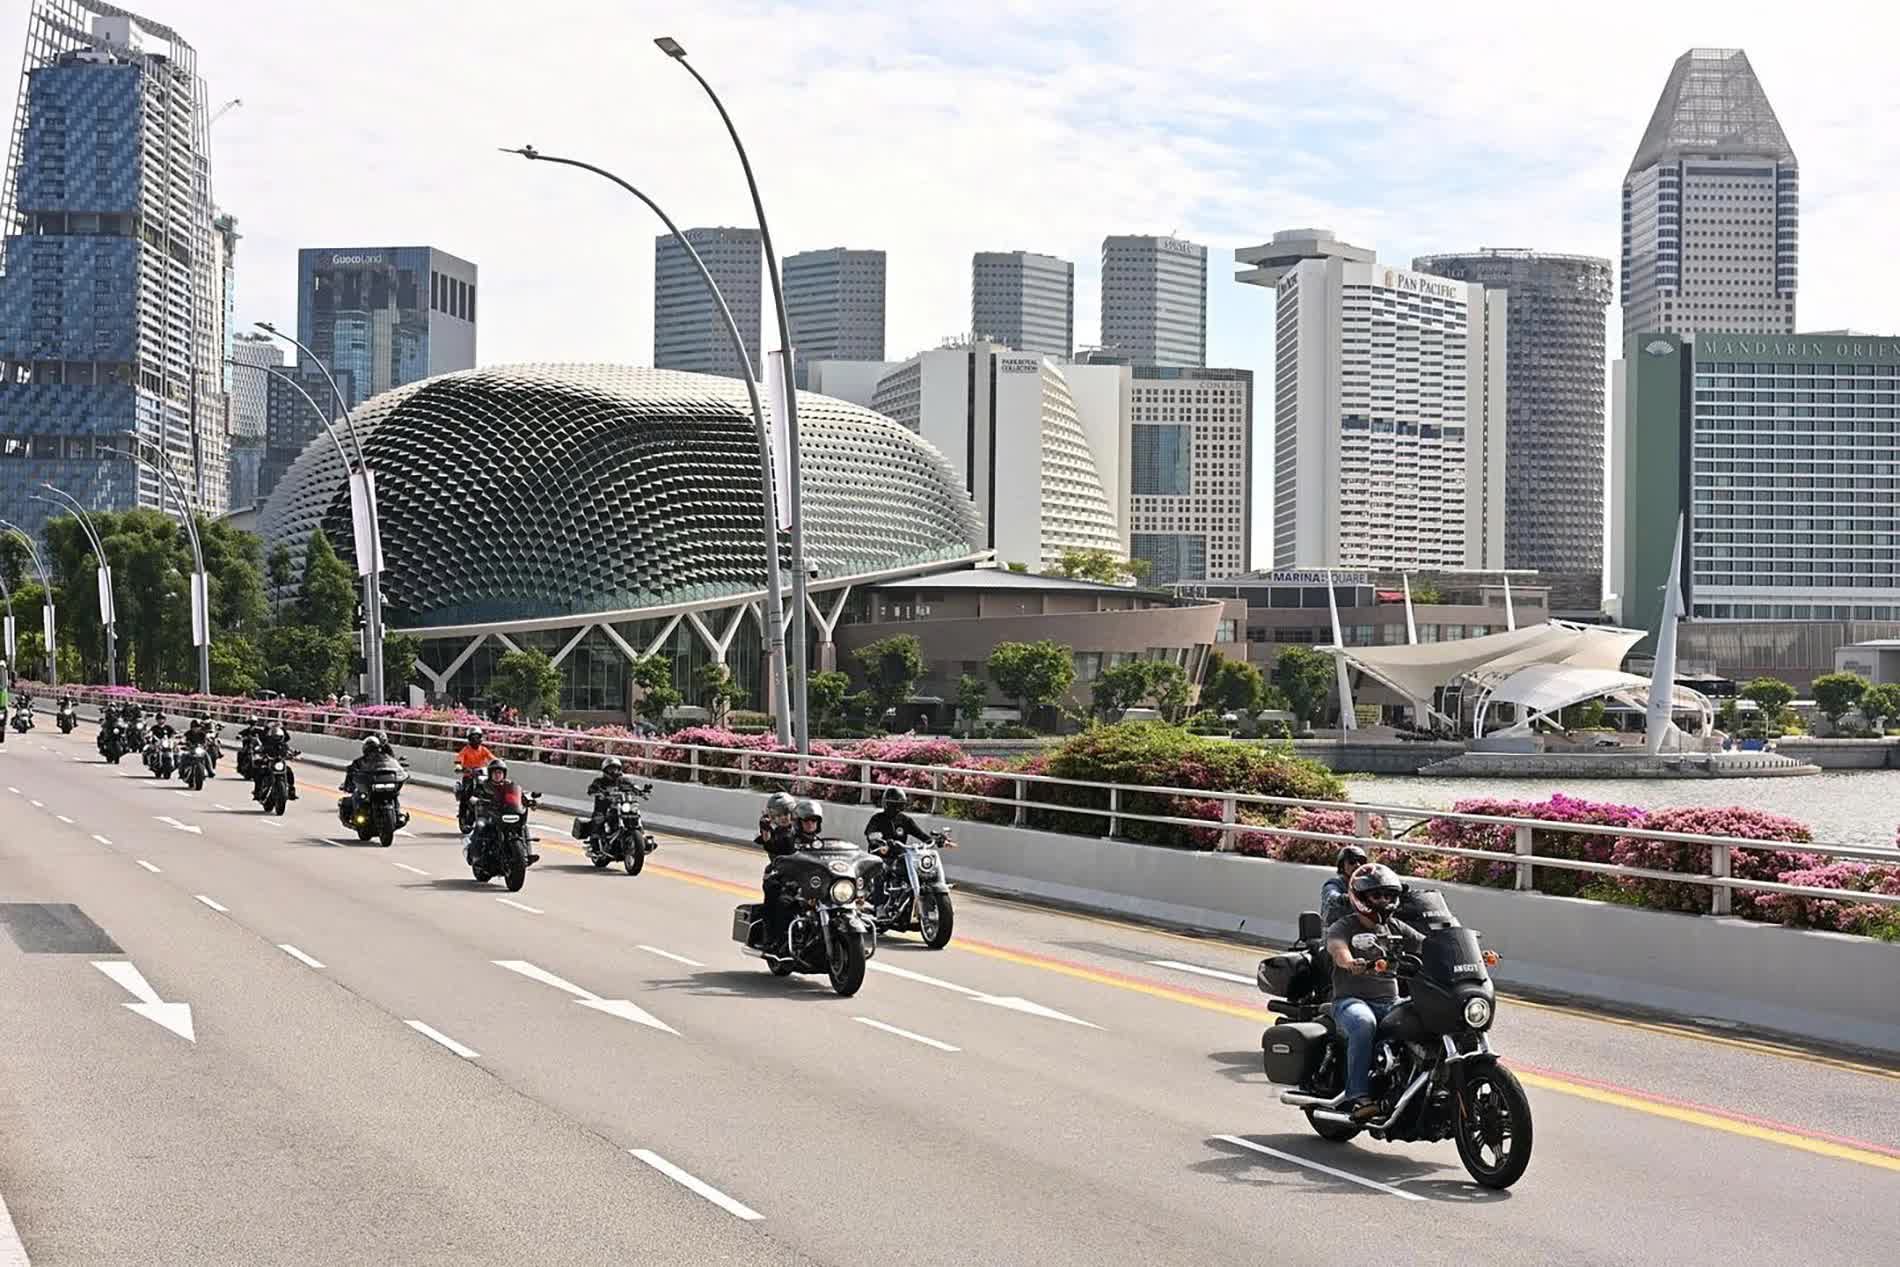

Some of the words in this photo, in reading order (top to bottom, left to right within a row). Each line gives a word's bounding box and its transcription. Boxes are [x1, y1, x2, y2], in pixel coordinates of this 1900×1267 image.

[1398, 274, 1417, 290] PAN
[1420, 278, 1457, 298] PACIFIC
[1704, 341, 1823, 357] MANDARIN
